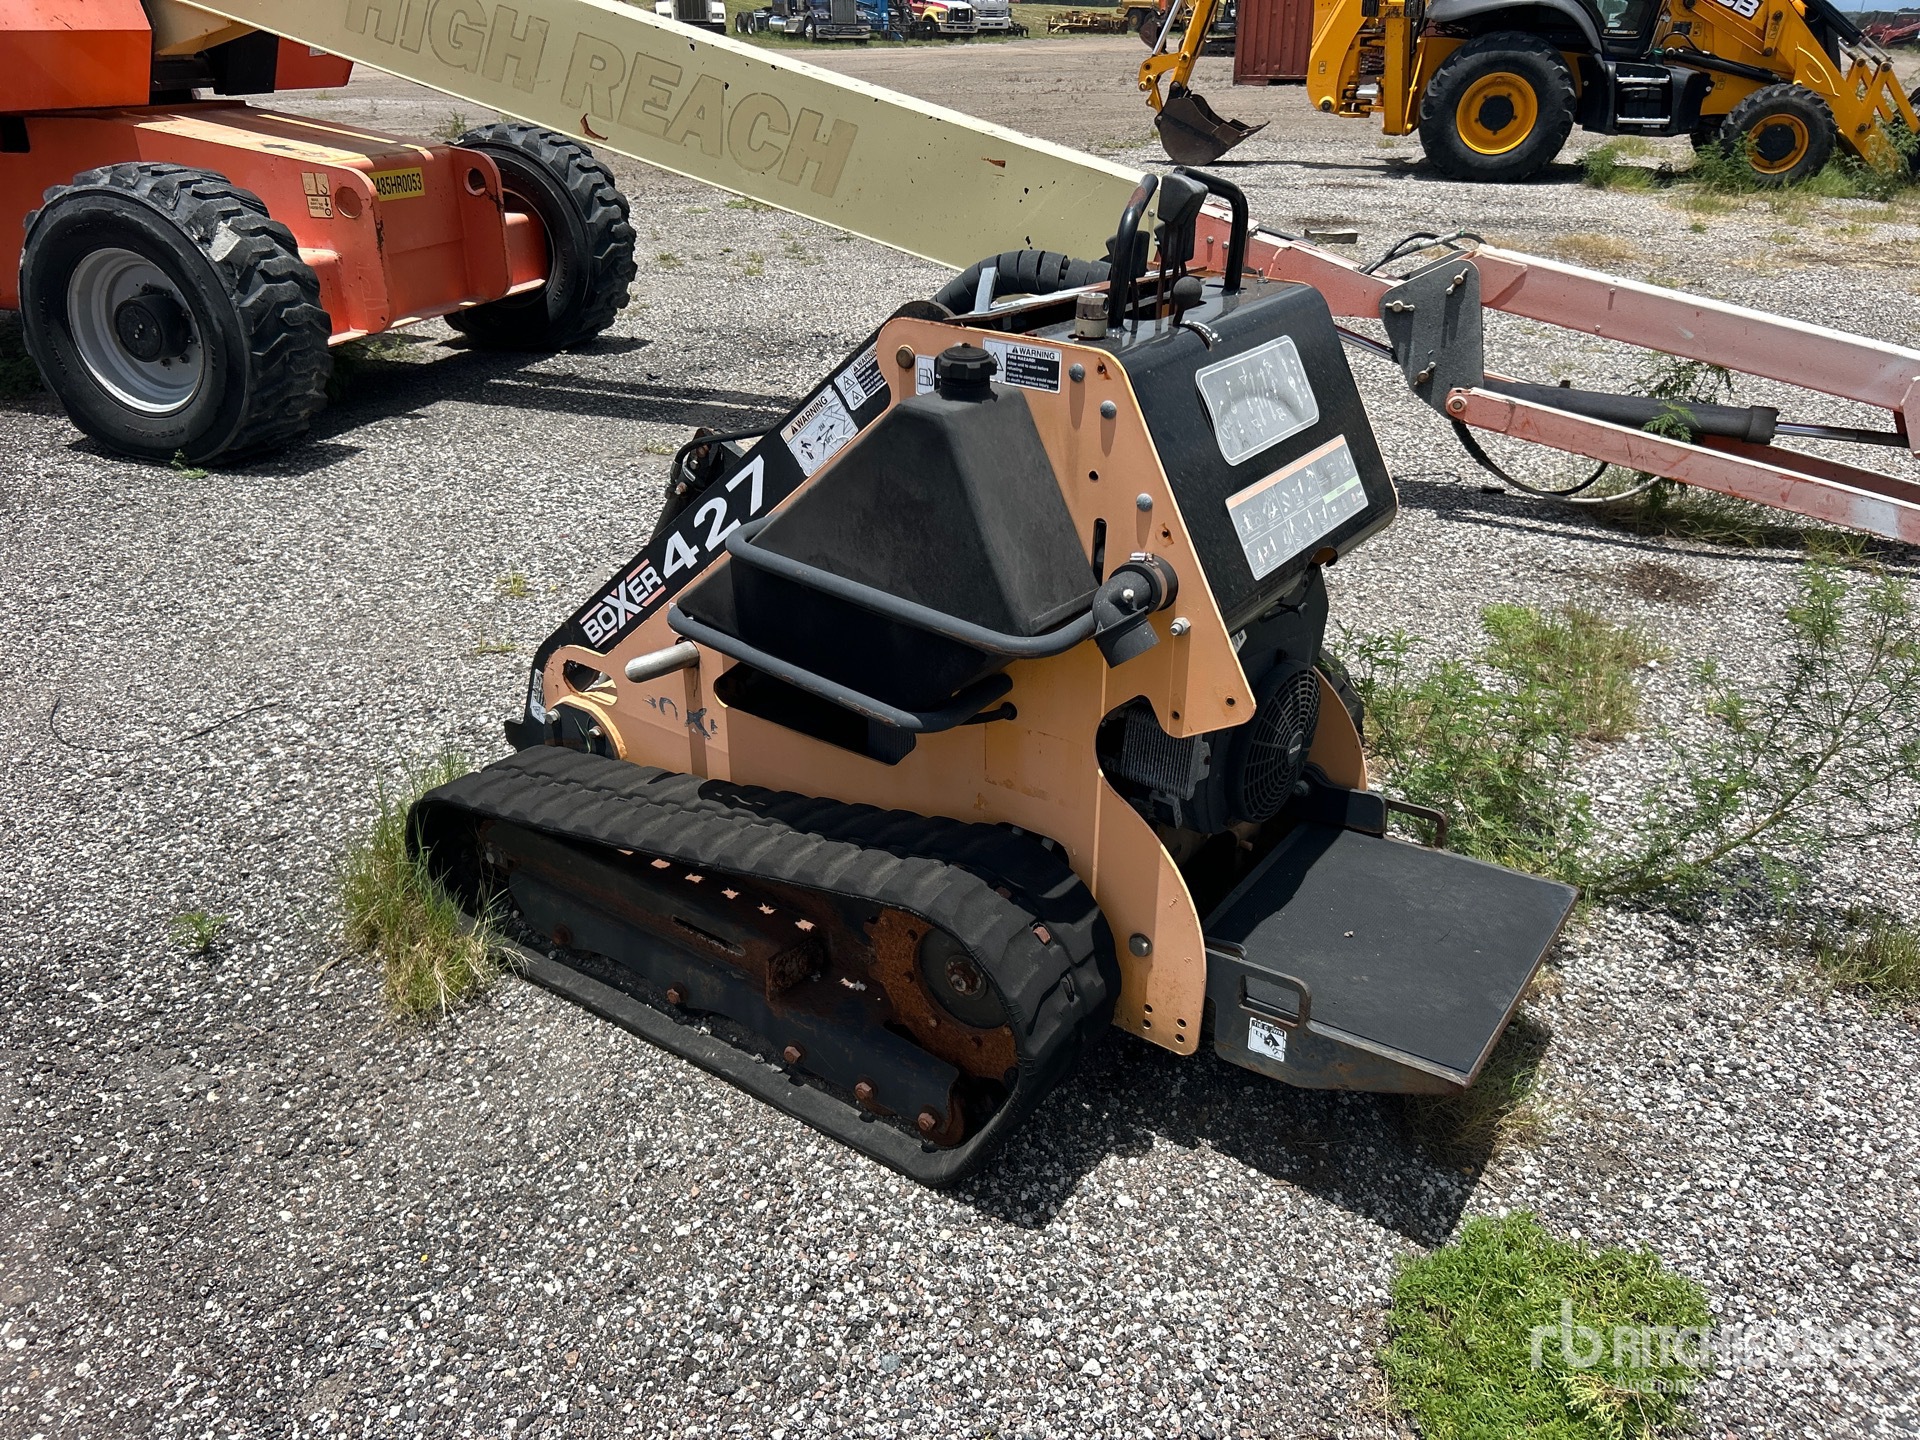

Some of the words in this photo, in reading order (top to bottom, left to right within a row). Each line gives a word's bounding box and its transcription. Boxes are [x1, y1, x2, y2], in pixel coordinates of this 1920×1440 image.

[561, 32, 859, 197] REACH
[1019, 347, 1055, 359] WARNING
[795, 395, 828, 429] WARNING
[582, 566, 663, 644] BOXER
[662, 454, 765, 579] 427
